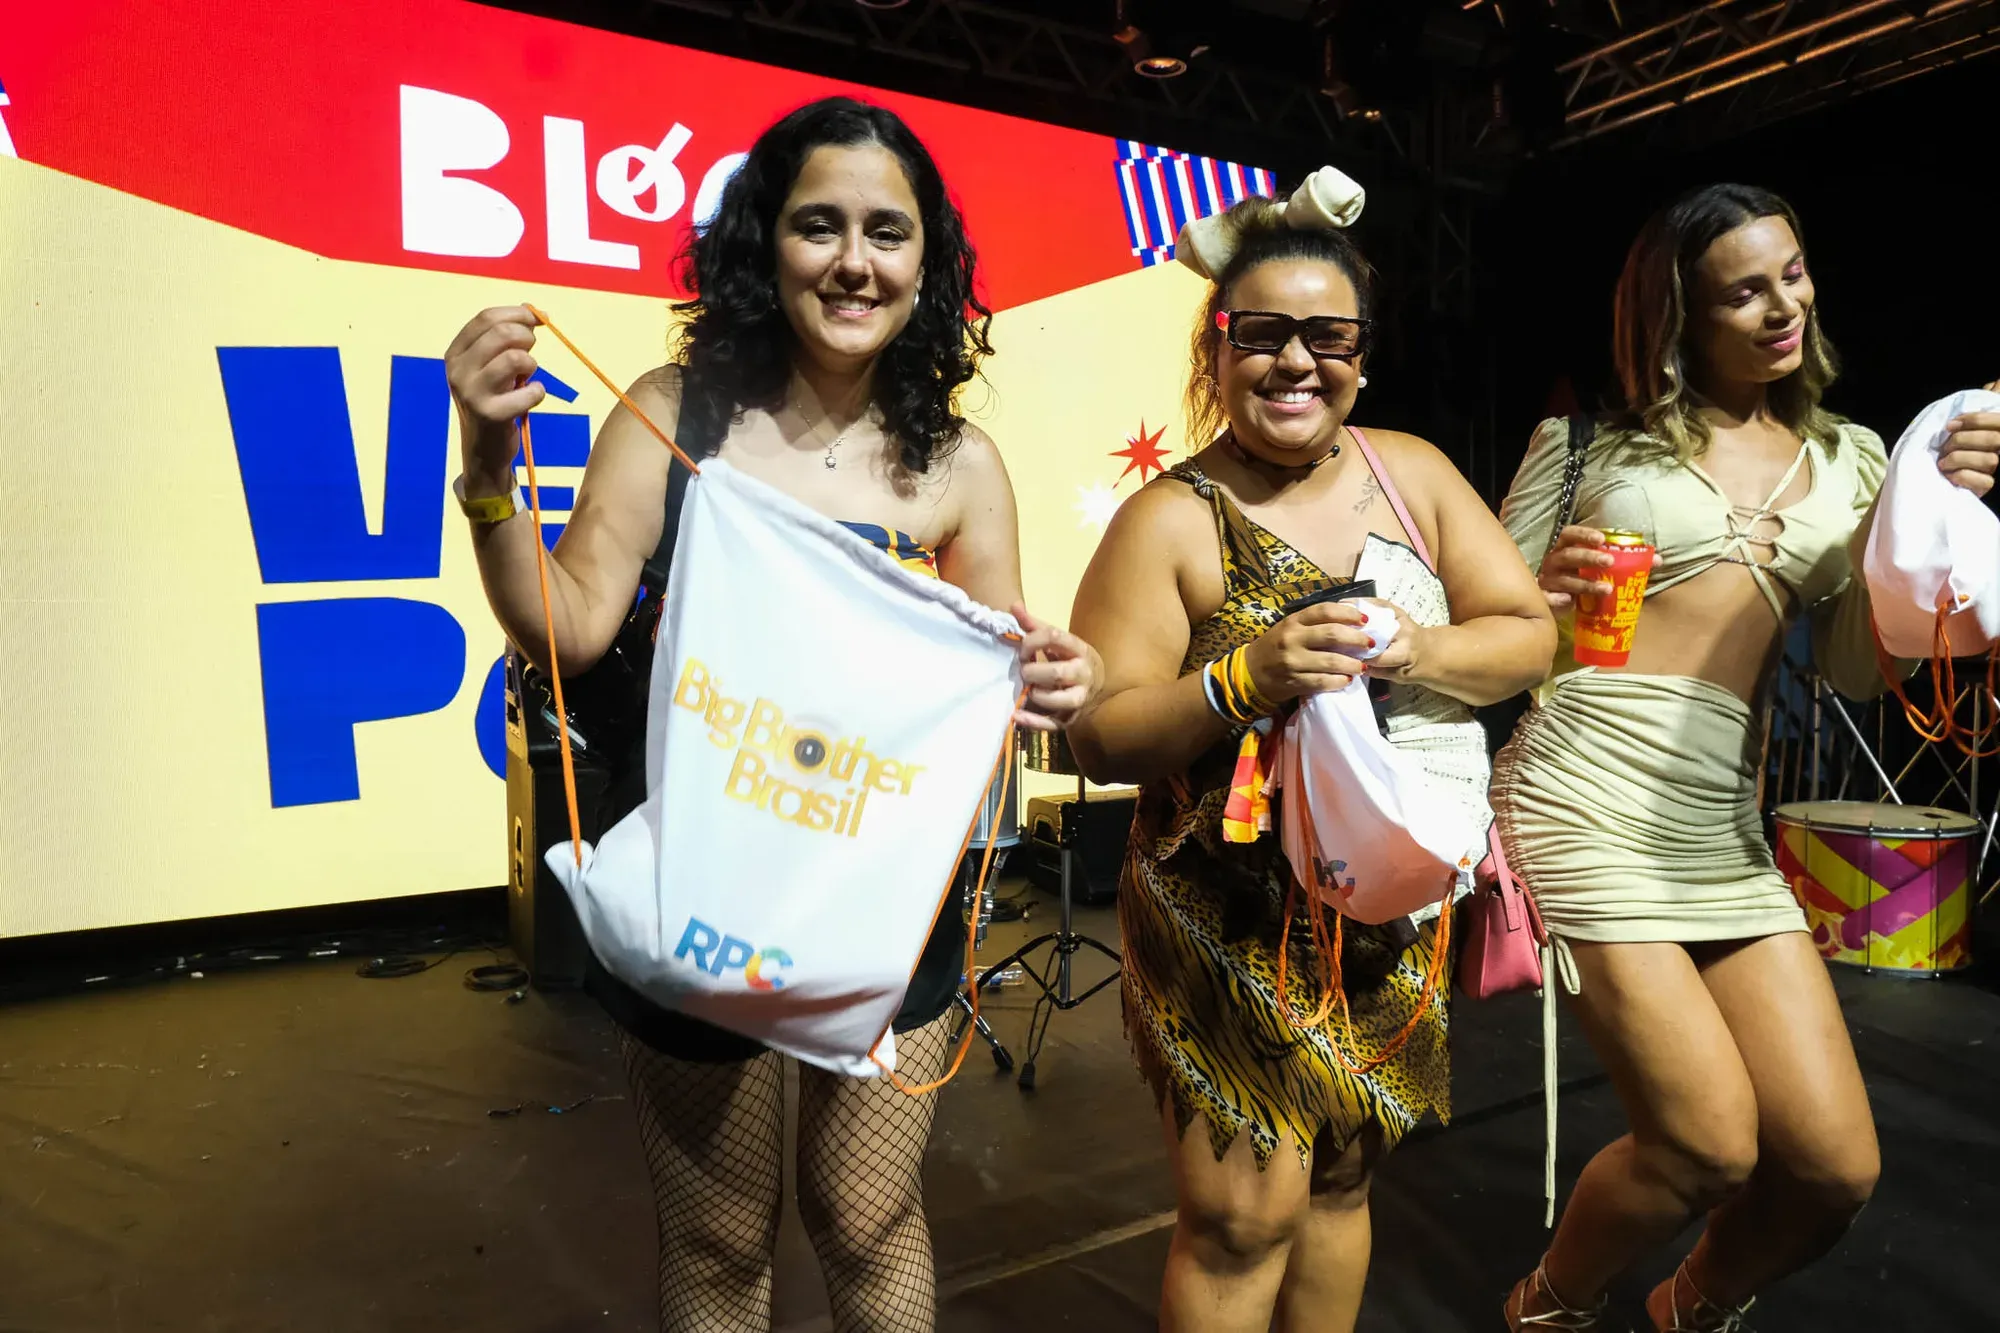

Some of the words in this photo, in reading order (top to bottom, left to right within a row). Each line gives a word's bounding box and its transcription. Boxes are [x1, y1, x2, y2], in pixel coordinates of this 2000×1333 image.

[673, 657, 748, 749] Big
[741, 696, 927, 796] Brother
[723, 747, 873, 837] Brasil
[673, 915, 793, 991] RPC
